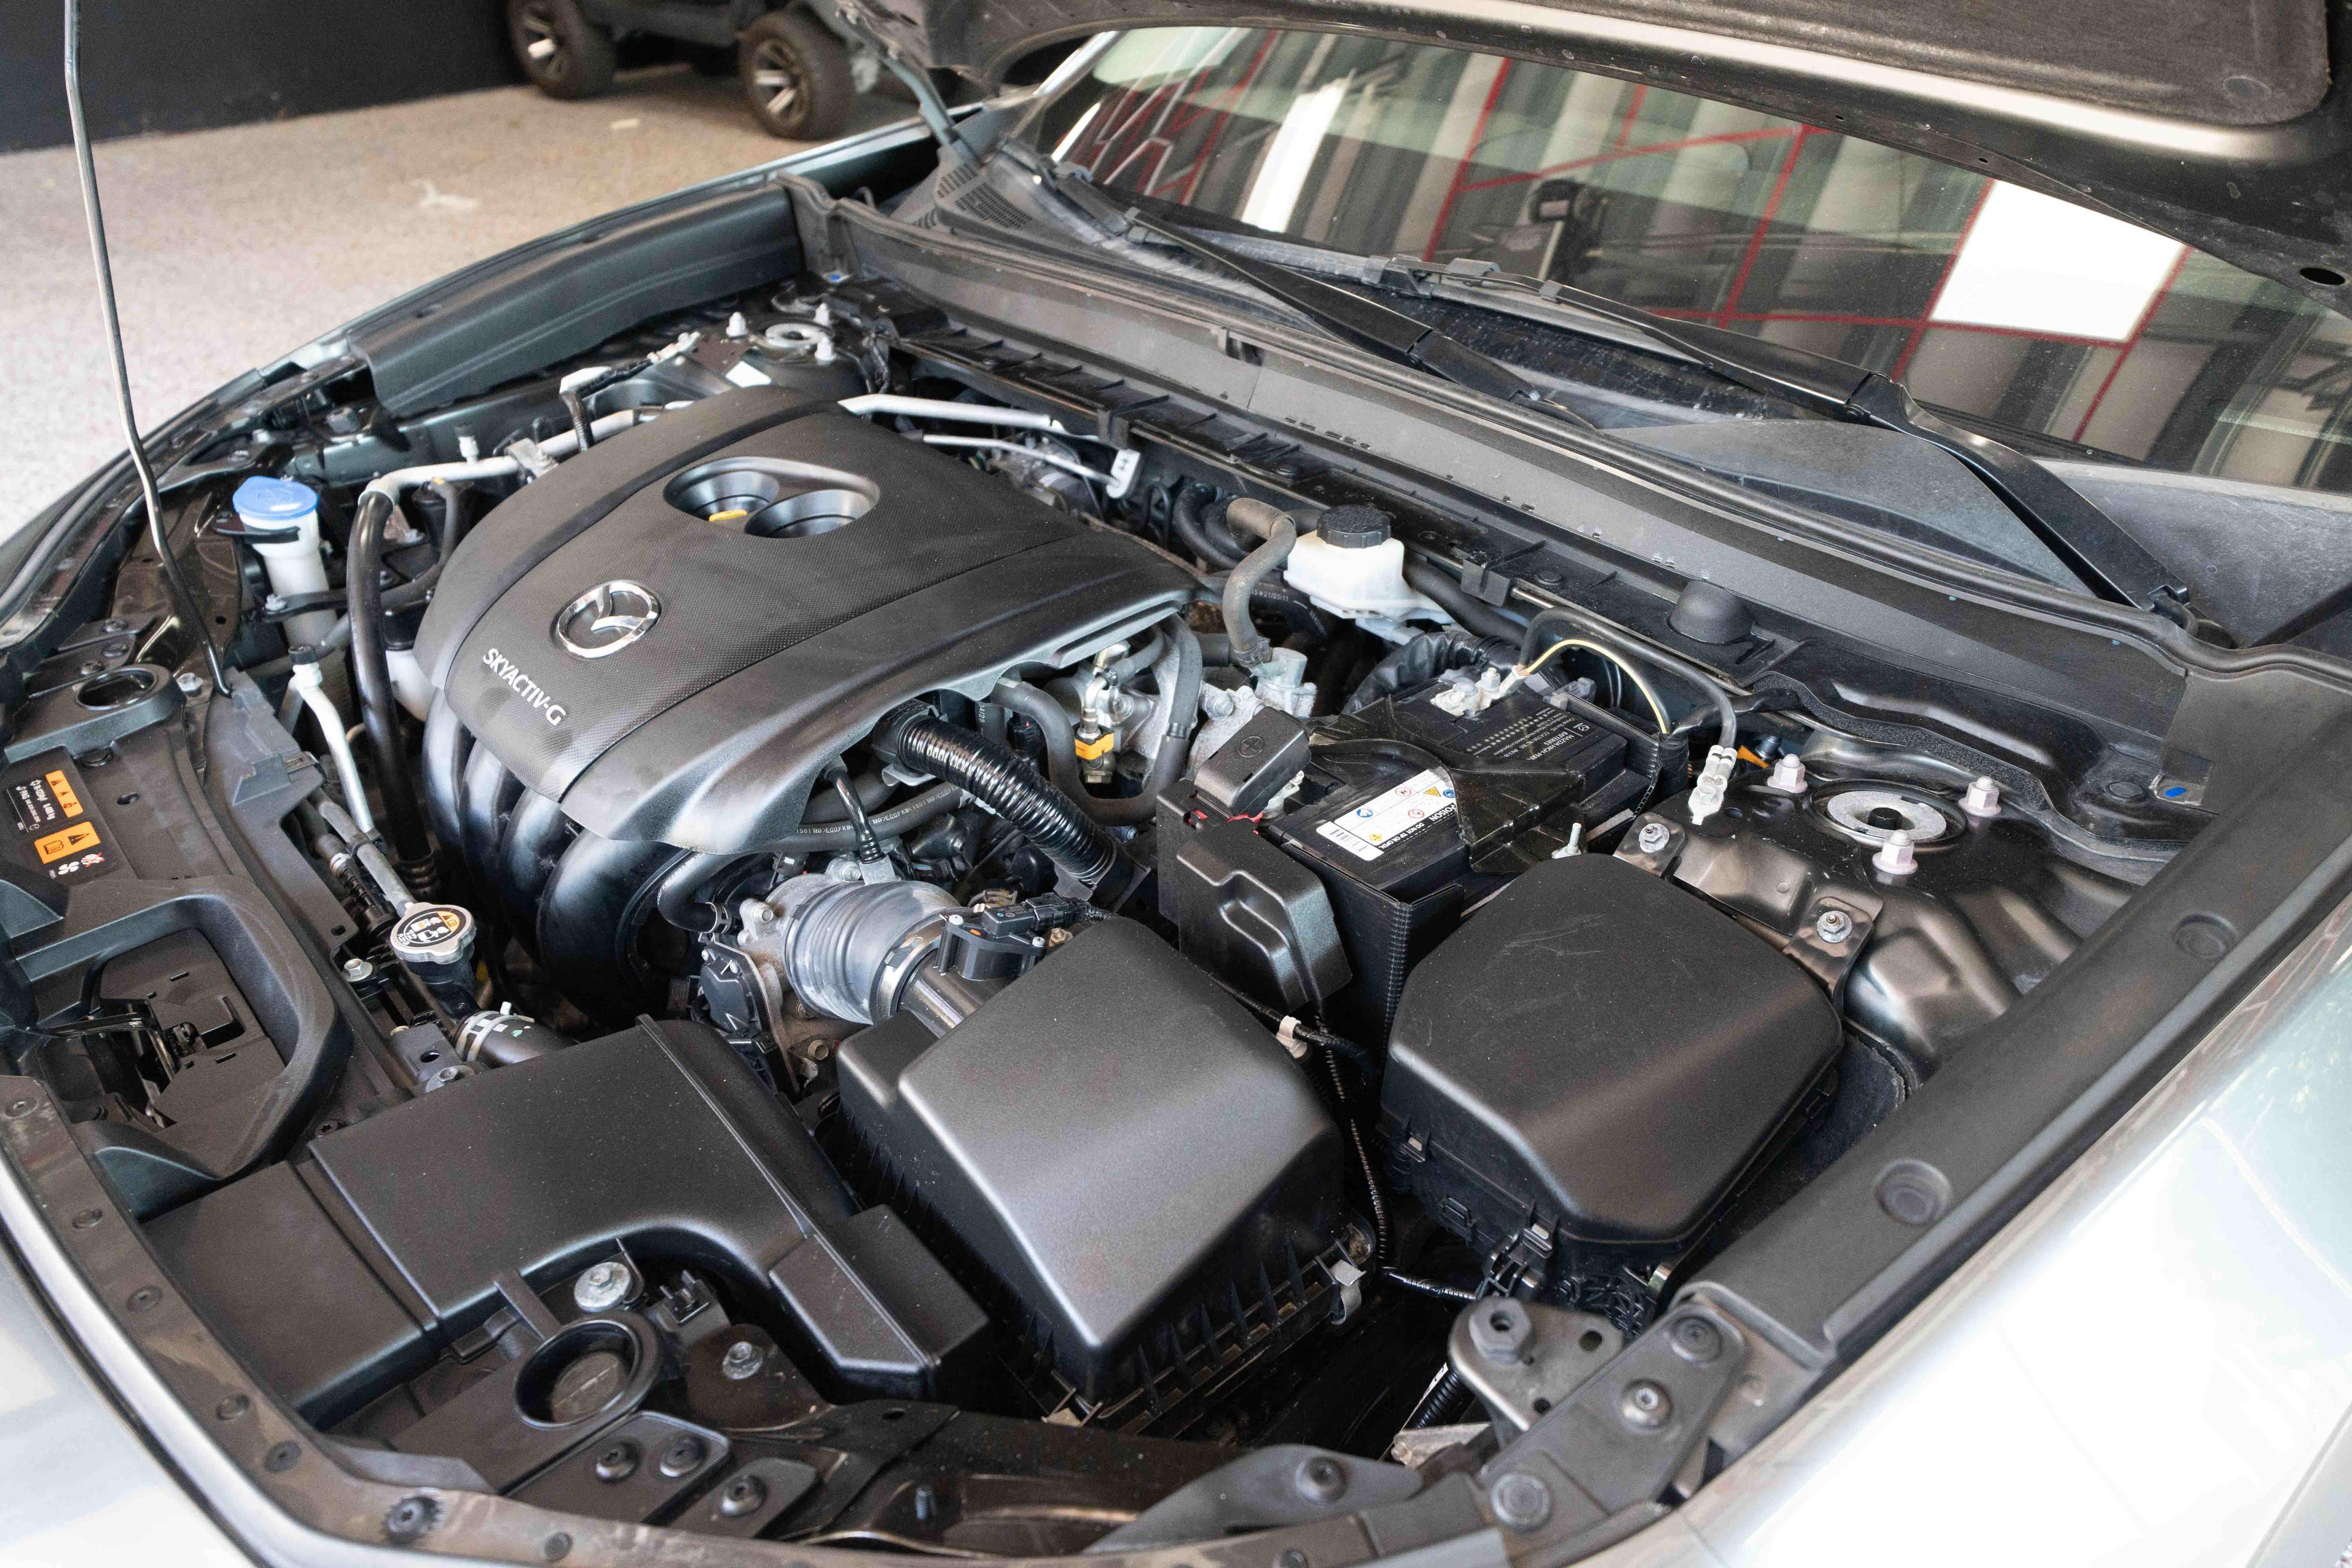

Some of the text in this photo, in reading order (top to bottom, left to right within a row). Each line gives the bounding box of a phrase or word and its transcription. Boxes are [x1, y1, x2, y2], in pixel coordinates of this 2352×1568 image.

[483, 648, 567, 726] SKYACTIV-G
[1544, 731, 1568, 745] BATTERIES
[1554, 734, 1574, 746] MAZDA
[1429, 804, 1456, 822] POISON
